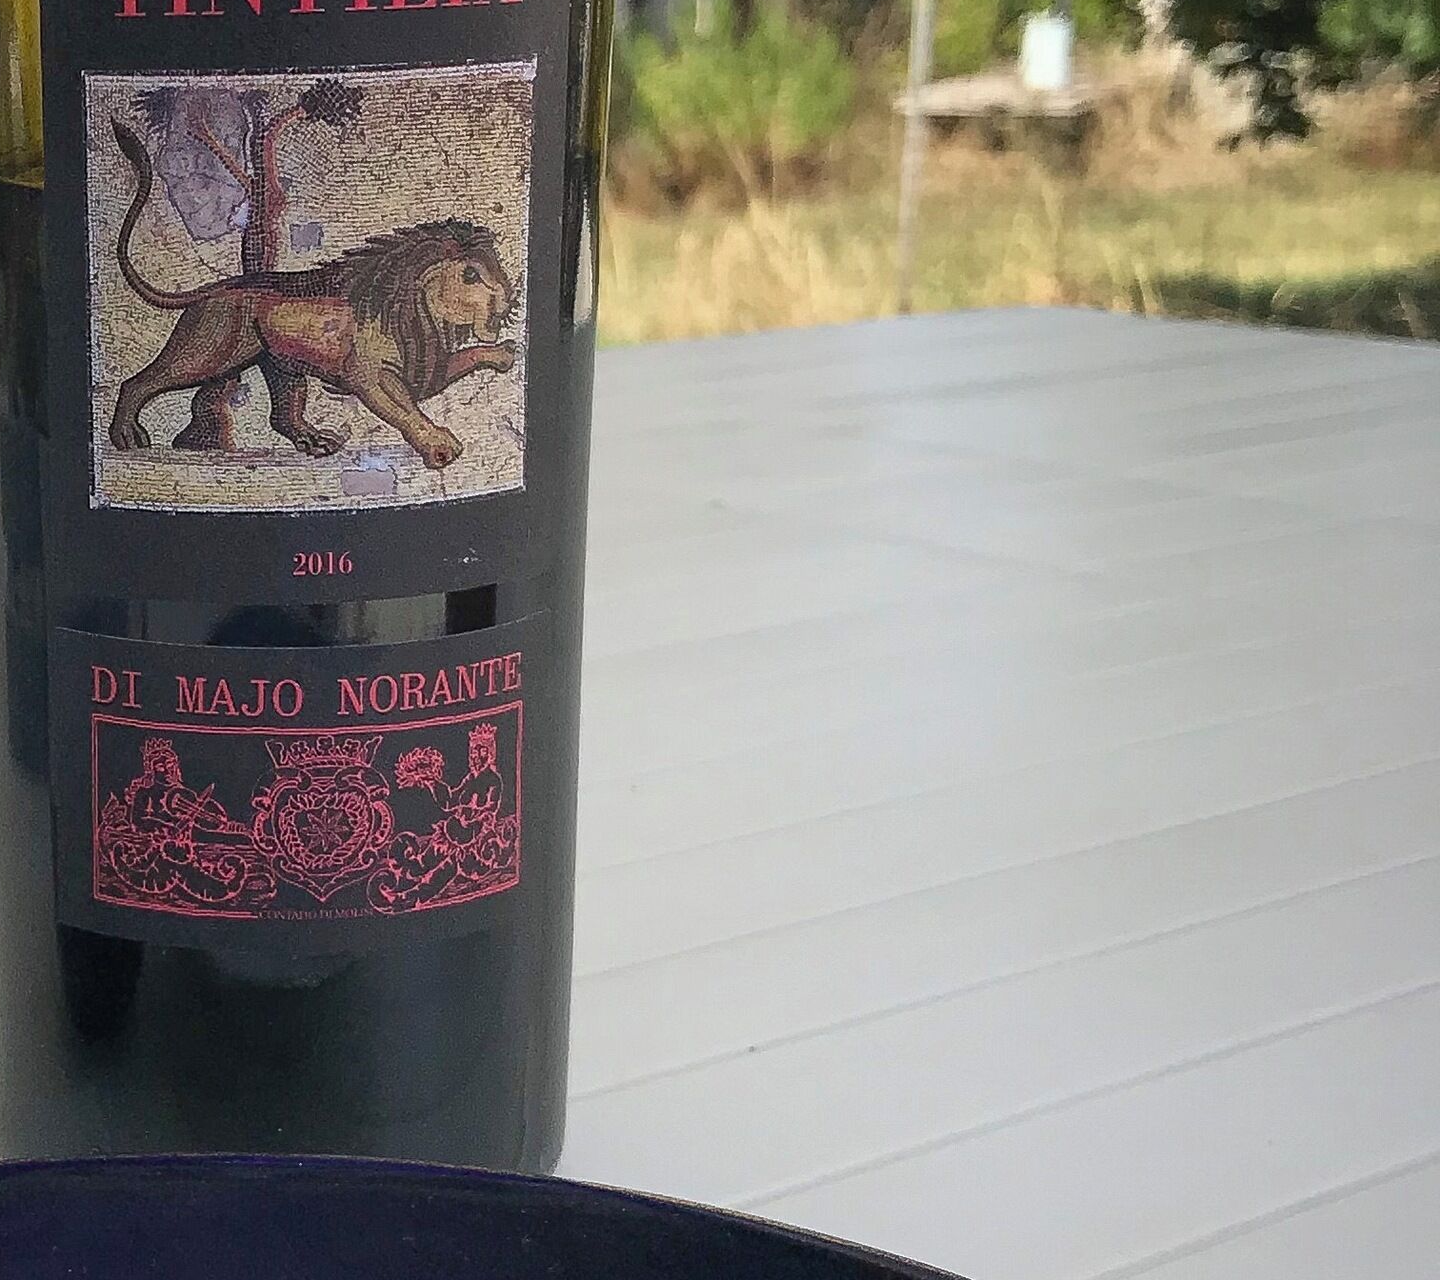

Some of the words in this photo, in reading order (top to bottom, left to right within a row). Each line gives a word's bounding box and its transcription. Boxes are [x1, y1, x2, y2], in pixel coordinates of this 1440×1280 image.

[292, 551, 354, 577] 2016
[91, 665, 142, 709] DI
[176, 676, 305, 718] MAJO
[336, 651, 523, 716] NORANTE
